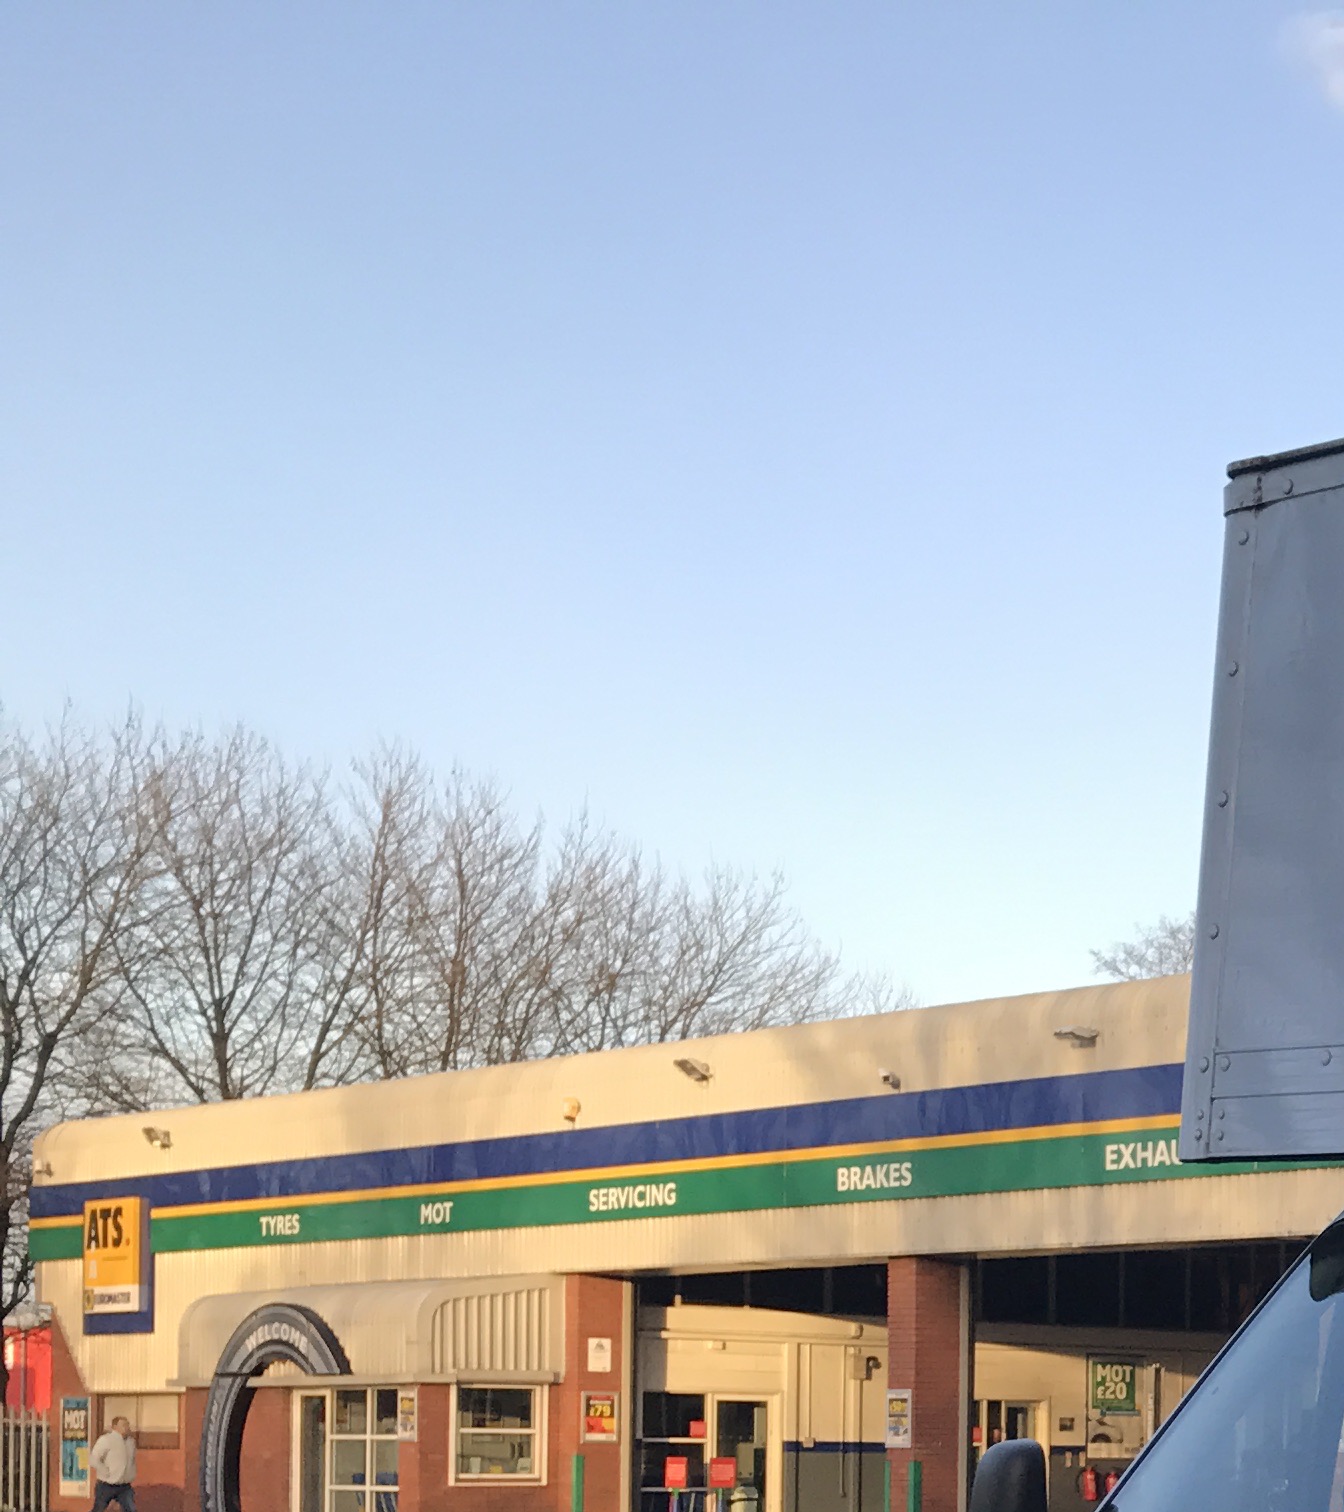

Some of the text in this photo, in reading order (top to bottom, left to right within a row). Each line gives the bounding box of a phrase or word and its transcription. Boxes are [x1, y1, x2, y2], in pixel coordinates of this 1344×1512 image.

[836, 1161, 913, 1192] BRAKES
[588, 1181, 677, 1212] SERVICING
[259, 1213, 301, 1237] TYRES
[419, 1201, 454, 1225] MOT
[245, 1321, 309, 1354] WELCOME
[1096, 1363, 1134, 1383] MOT
[1096, 1381, 1127, 1400] £20
[64, 1409, 87, 1430] MOT
